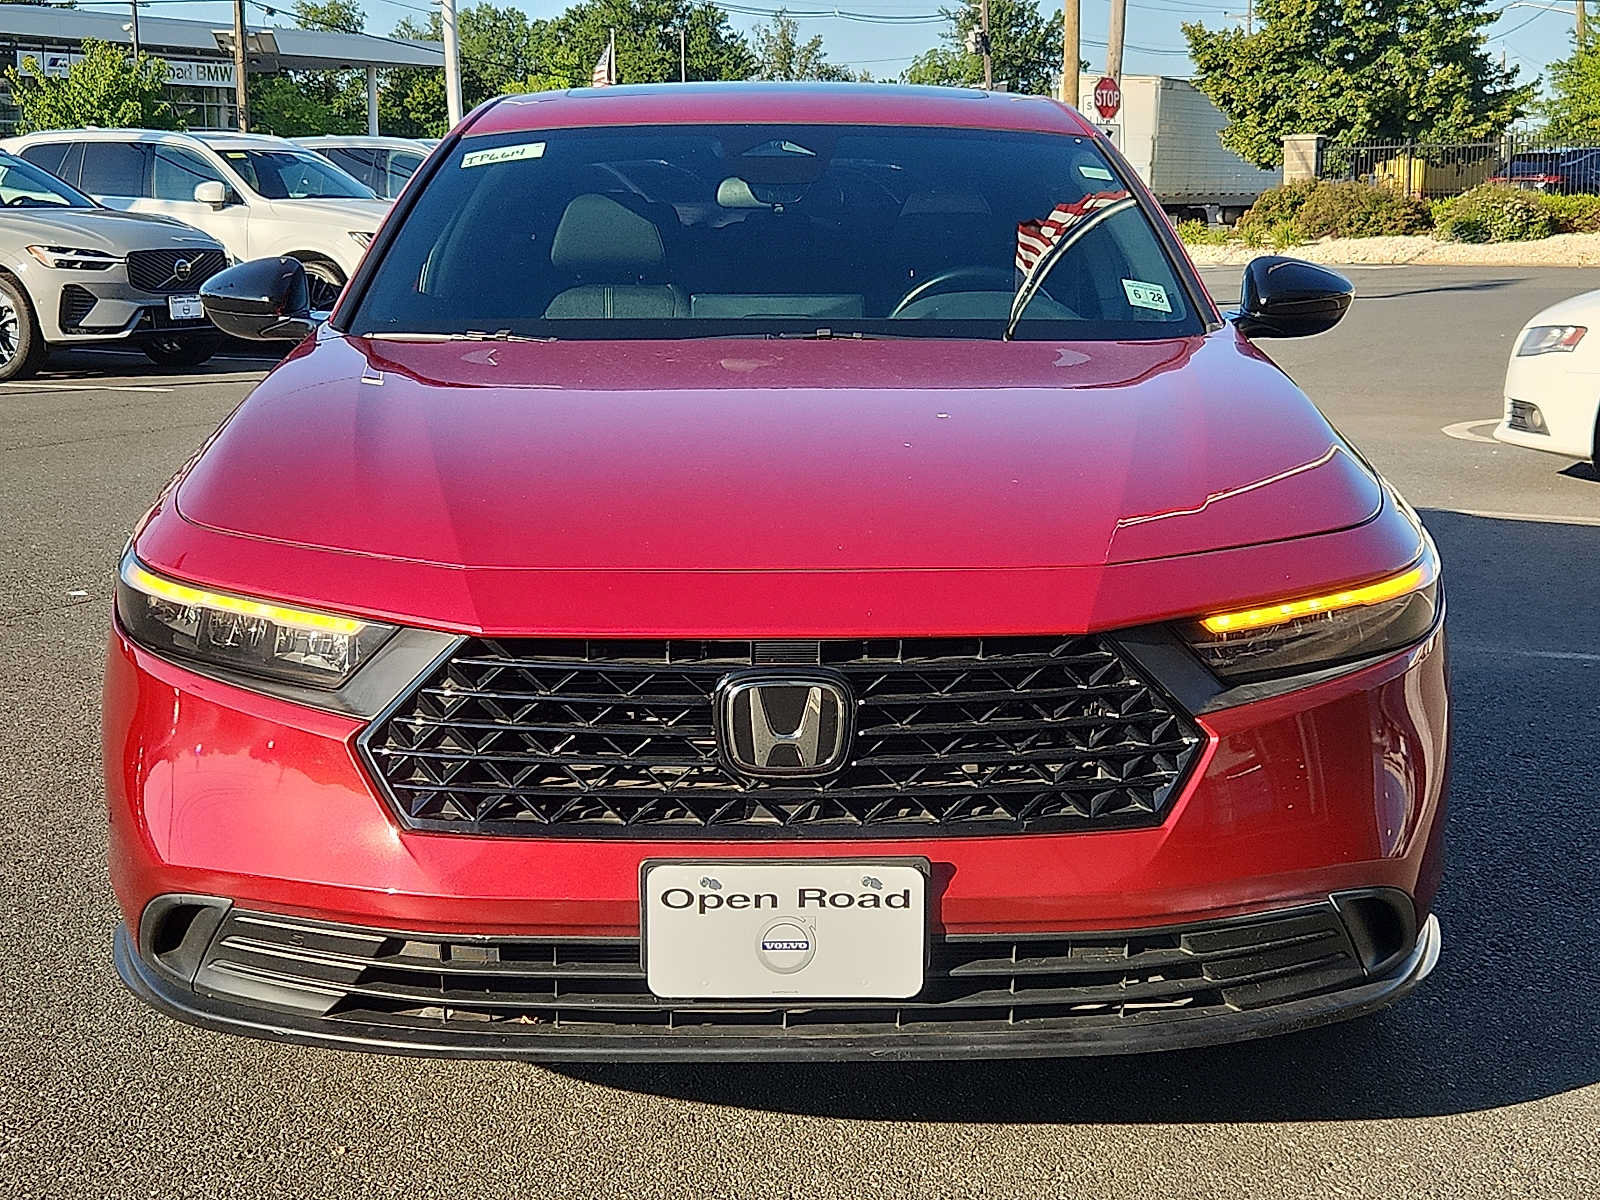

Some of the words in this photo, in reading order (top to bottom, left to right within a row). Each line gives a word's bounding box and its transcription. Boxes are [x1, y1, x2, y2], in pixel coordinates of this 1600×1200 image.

[196, 65, 232, 81] BMW
[1095, 90, 1120, 107] STOP
[1133, 289, 1142, 299] 6
[1149, 292, 1165, 303] 28
[660, 888, 778, 914] Open
[798, 888, 911, 909] Road
